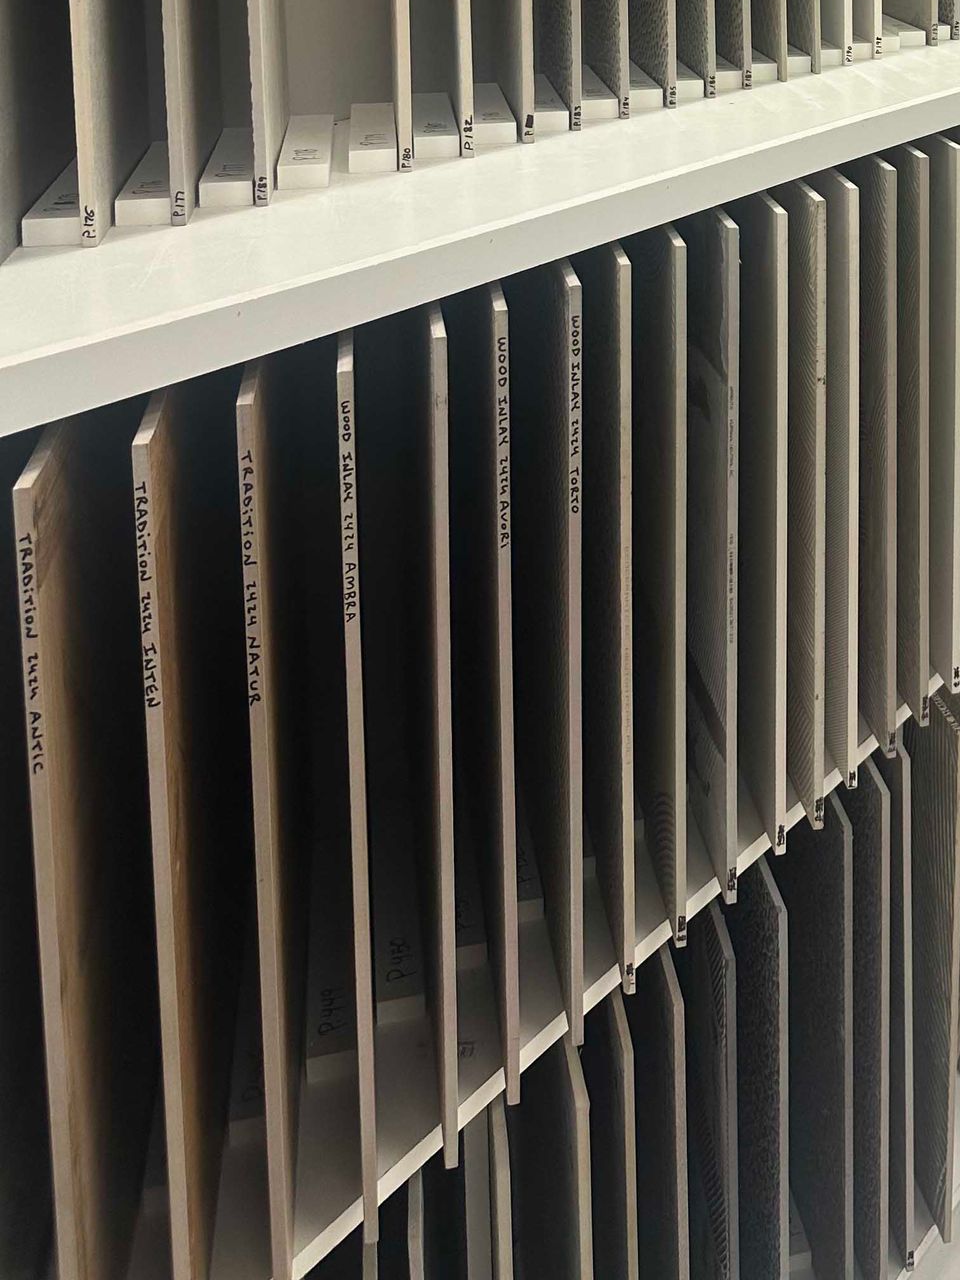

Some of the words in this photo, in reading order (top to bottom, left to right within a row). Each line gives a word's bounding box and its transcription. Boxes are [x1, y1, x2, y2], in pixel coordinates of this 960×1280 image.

[463, 115, 474, 151] P.182
[570, 315, 580, 357] WOOD
[498, 336, 508, 387] WOOD
[570, 362, 580, 412] INLAY
[341, 400, 352, 442] WOOD
[498, 396, 508, 446] INLAY
[570, 418, 580, 458] 2424
[342, 452, 354, 501] INLAY
[570, 466, 580, 514] TORTO
[344, 513, 354, 552] 2424
[142, 591, 153, 634] 2424
[246, 581, 257, 627] 2424
[344, 562, 357, 623] AMBRA
[27, 652, 39, 700] 2424
[144, 642, 161, 709] INTEN
[248, 636, 261, 707] NATUR
[28, 710, 44, 775] ANTIC
